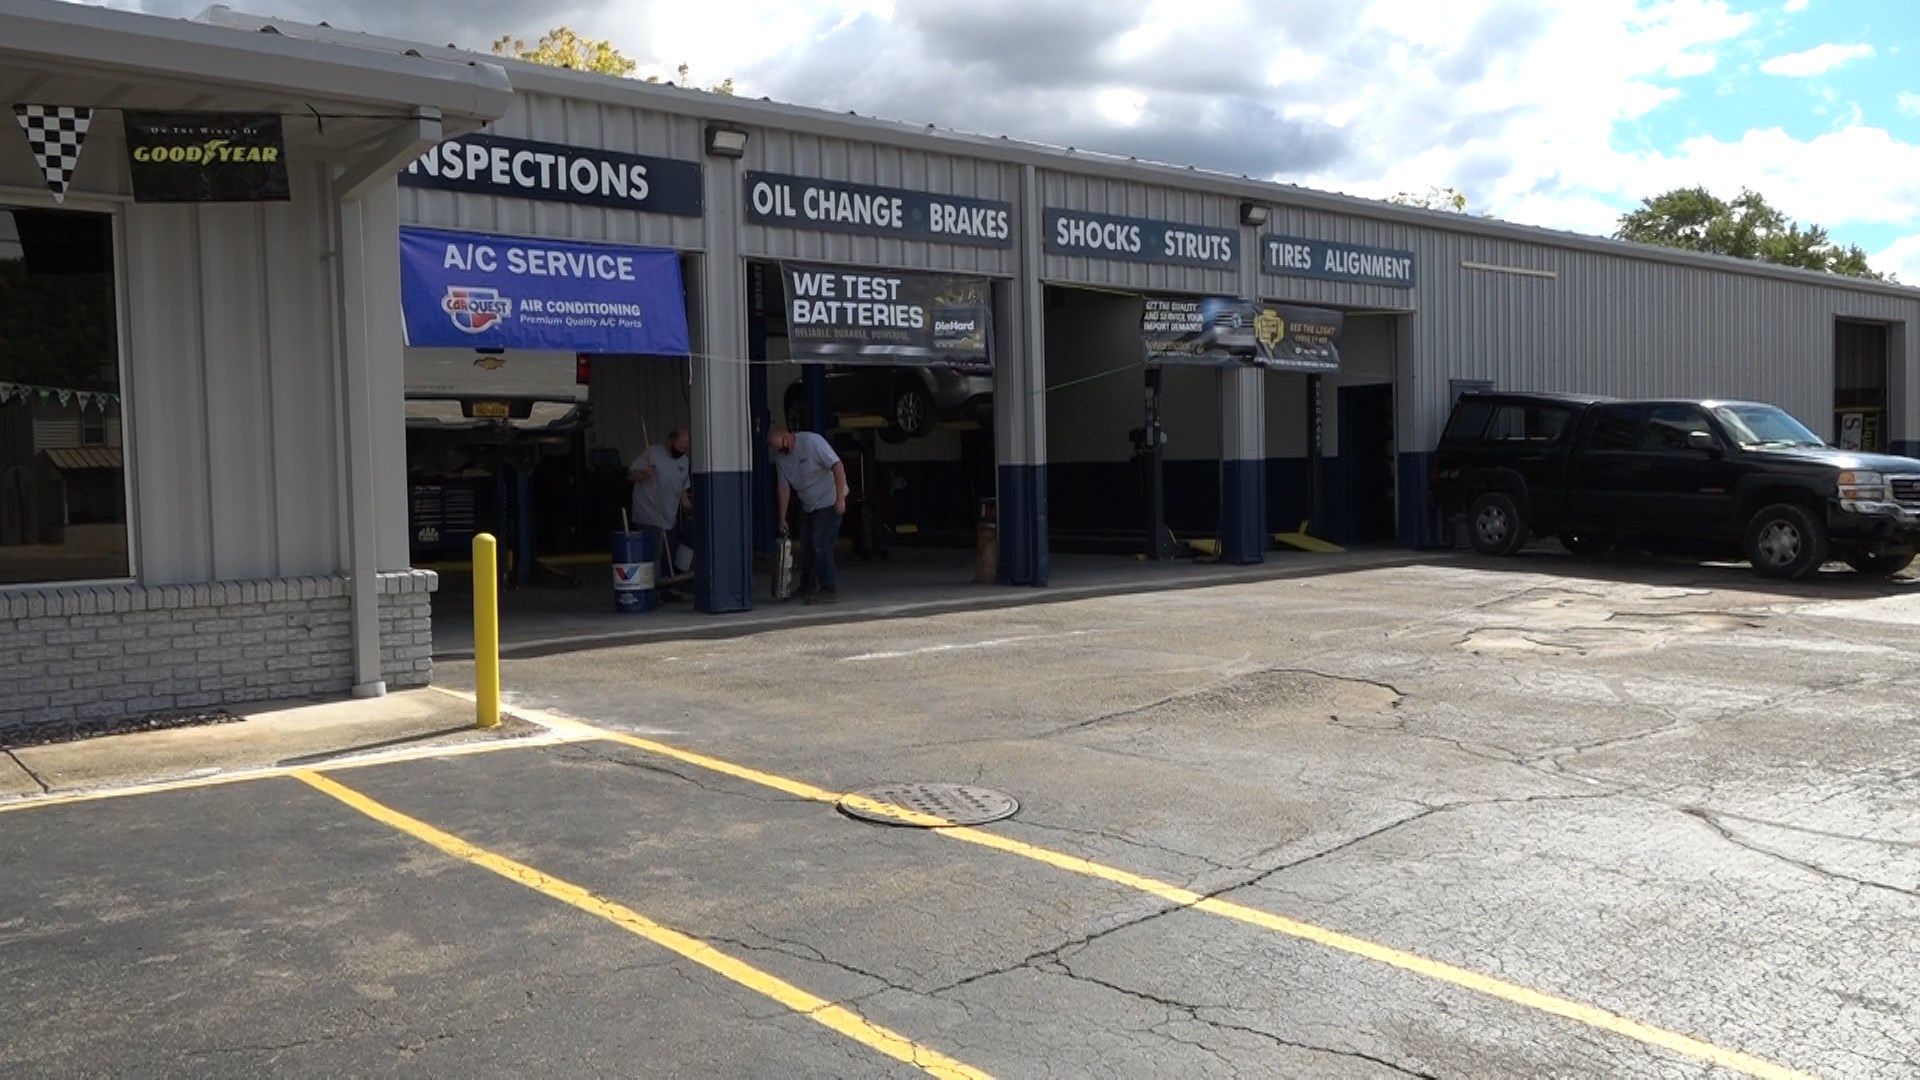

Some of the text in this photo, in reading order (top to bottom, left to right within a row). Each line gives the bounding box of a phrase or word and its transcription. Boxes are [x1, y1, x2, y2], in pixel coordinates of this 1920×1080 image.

[134, 144, 278, 163] GOODYEAR
[402, 140, 650, 200] NSPECTIONS
[752, 181, 1009, 240] OIL CHANGE BRAKES
[1056, 217, 1232, 261] SHOCKS STRUTS
[444, 244, 636, 281] A/C SERVICE
[1269, 242, 1411, 280] TIRES ALIGNMENT
[793, 272, 836, 297] WE
[842, 275, 901, 300] TEST
[520, 299, 641, 316] AIR CONDITIONING
[520, 314, 563, 325] Premium
[566, 317, 598, 328] Quality
[619, 319, 643, 329] Parts
[793, 299, 923, 328] BATTERIES
